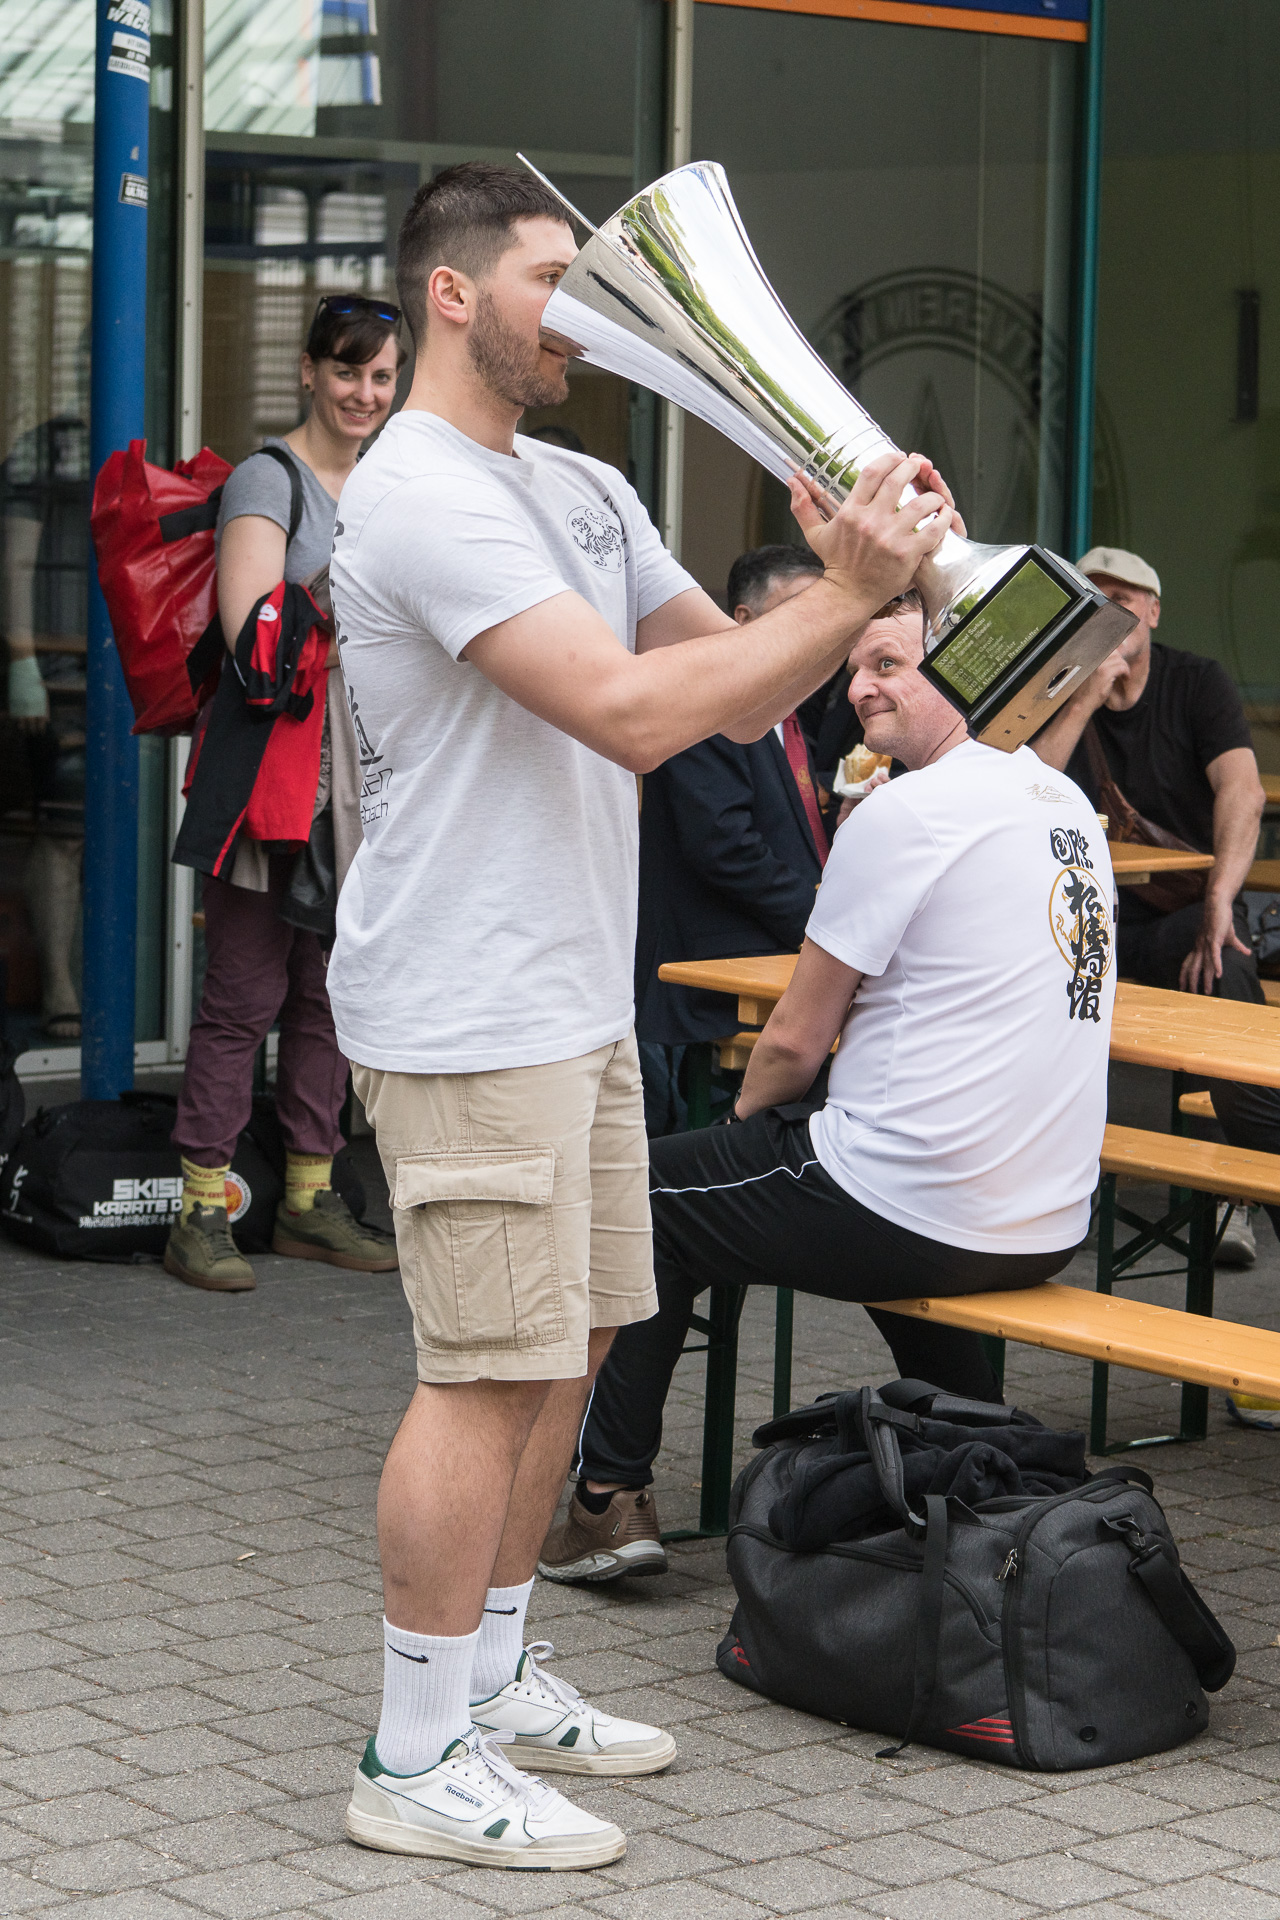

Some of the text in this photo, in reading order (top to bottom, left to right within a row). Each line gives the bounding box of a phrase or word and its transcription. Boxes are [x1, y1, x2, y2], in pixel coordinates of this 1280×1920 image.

[950, 633, 970, 653] Michael
[980, 657, 1009, 687] Alexandra
[93, 1200, 167, 1216] KARATE
[445, 1785, 475, 1805] Reebok
